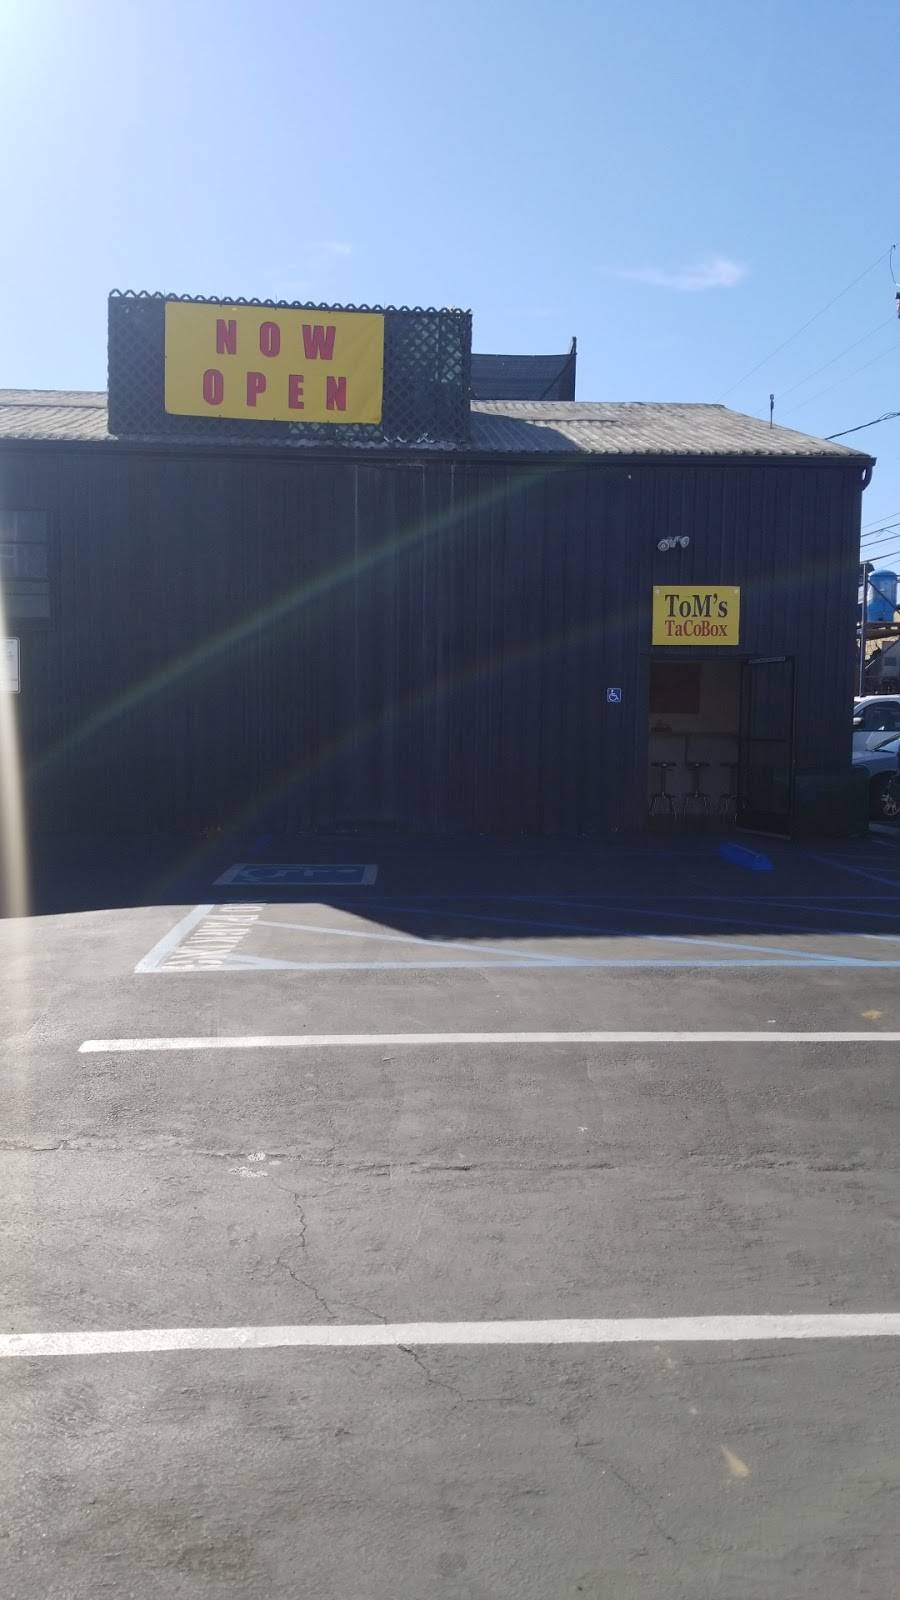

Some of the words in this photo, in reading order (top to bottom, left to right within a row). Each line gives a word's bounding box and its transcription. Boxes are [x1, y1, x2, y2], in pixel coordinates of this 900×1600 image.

[216, 318, 336, 360] NOW
[203, 369, 348, 411] OPEN
[664, 593, 728, 617] ToM's
[664, 620, 728, 636] TaCoBox
[160, 914, 260, 970] PARKING
